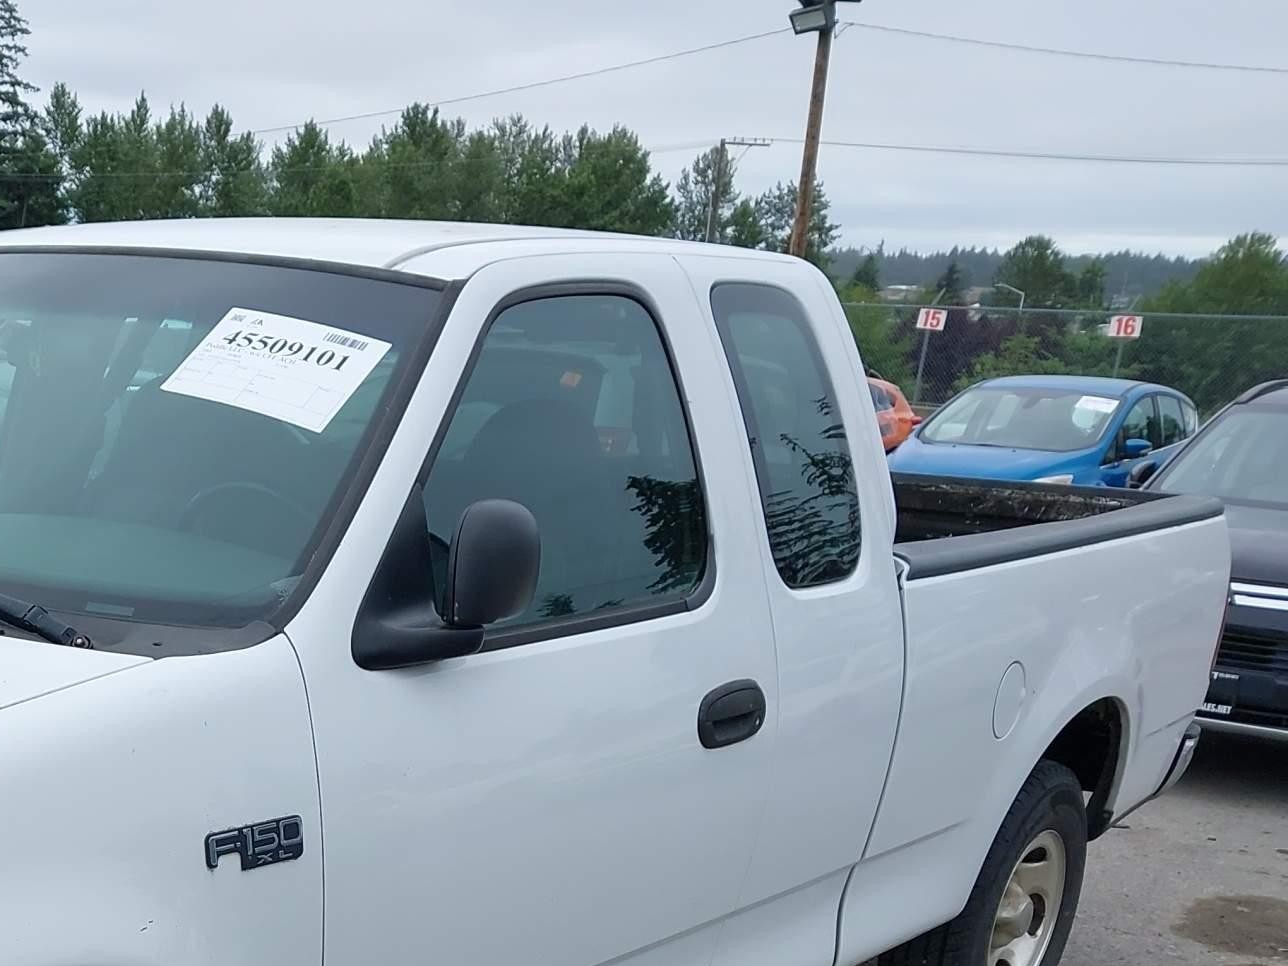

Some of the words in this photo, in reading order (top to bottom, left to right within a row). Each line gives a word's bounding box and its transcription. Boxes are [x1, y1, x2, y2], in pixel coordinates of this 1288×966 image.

[922, 310, 942, 328] 15
[1115, 316, 1137, 335] 16
[222, 329, 352, 372] 45509101
[1202, 702, 1233, 714] LES.NET
